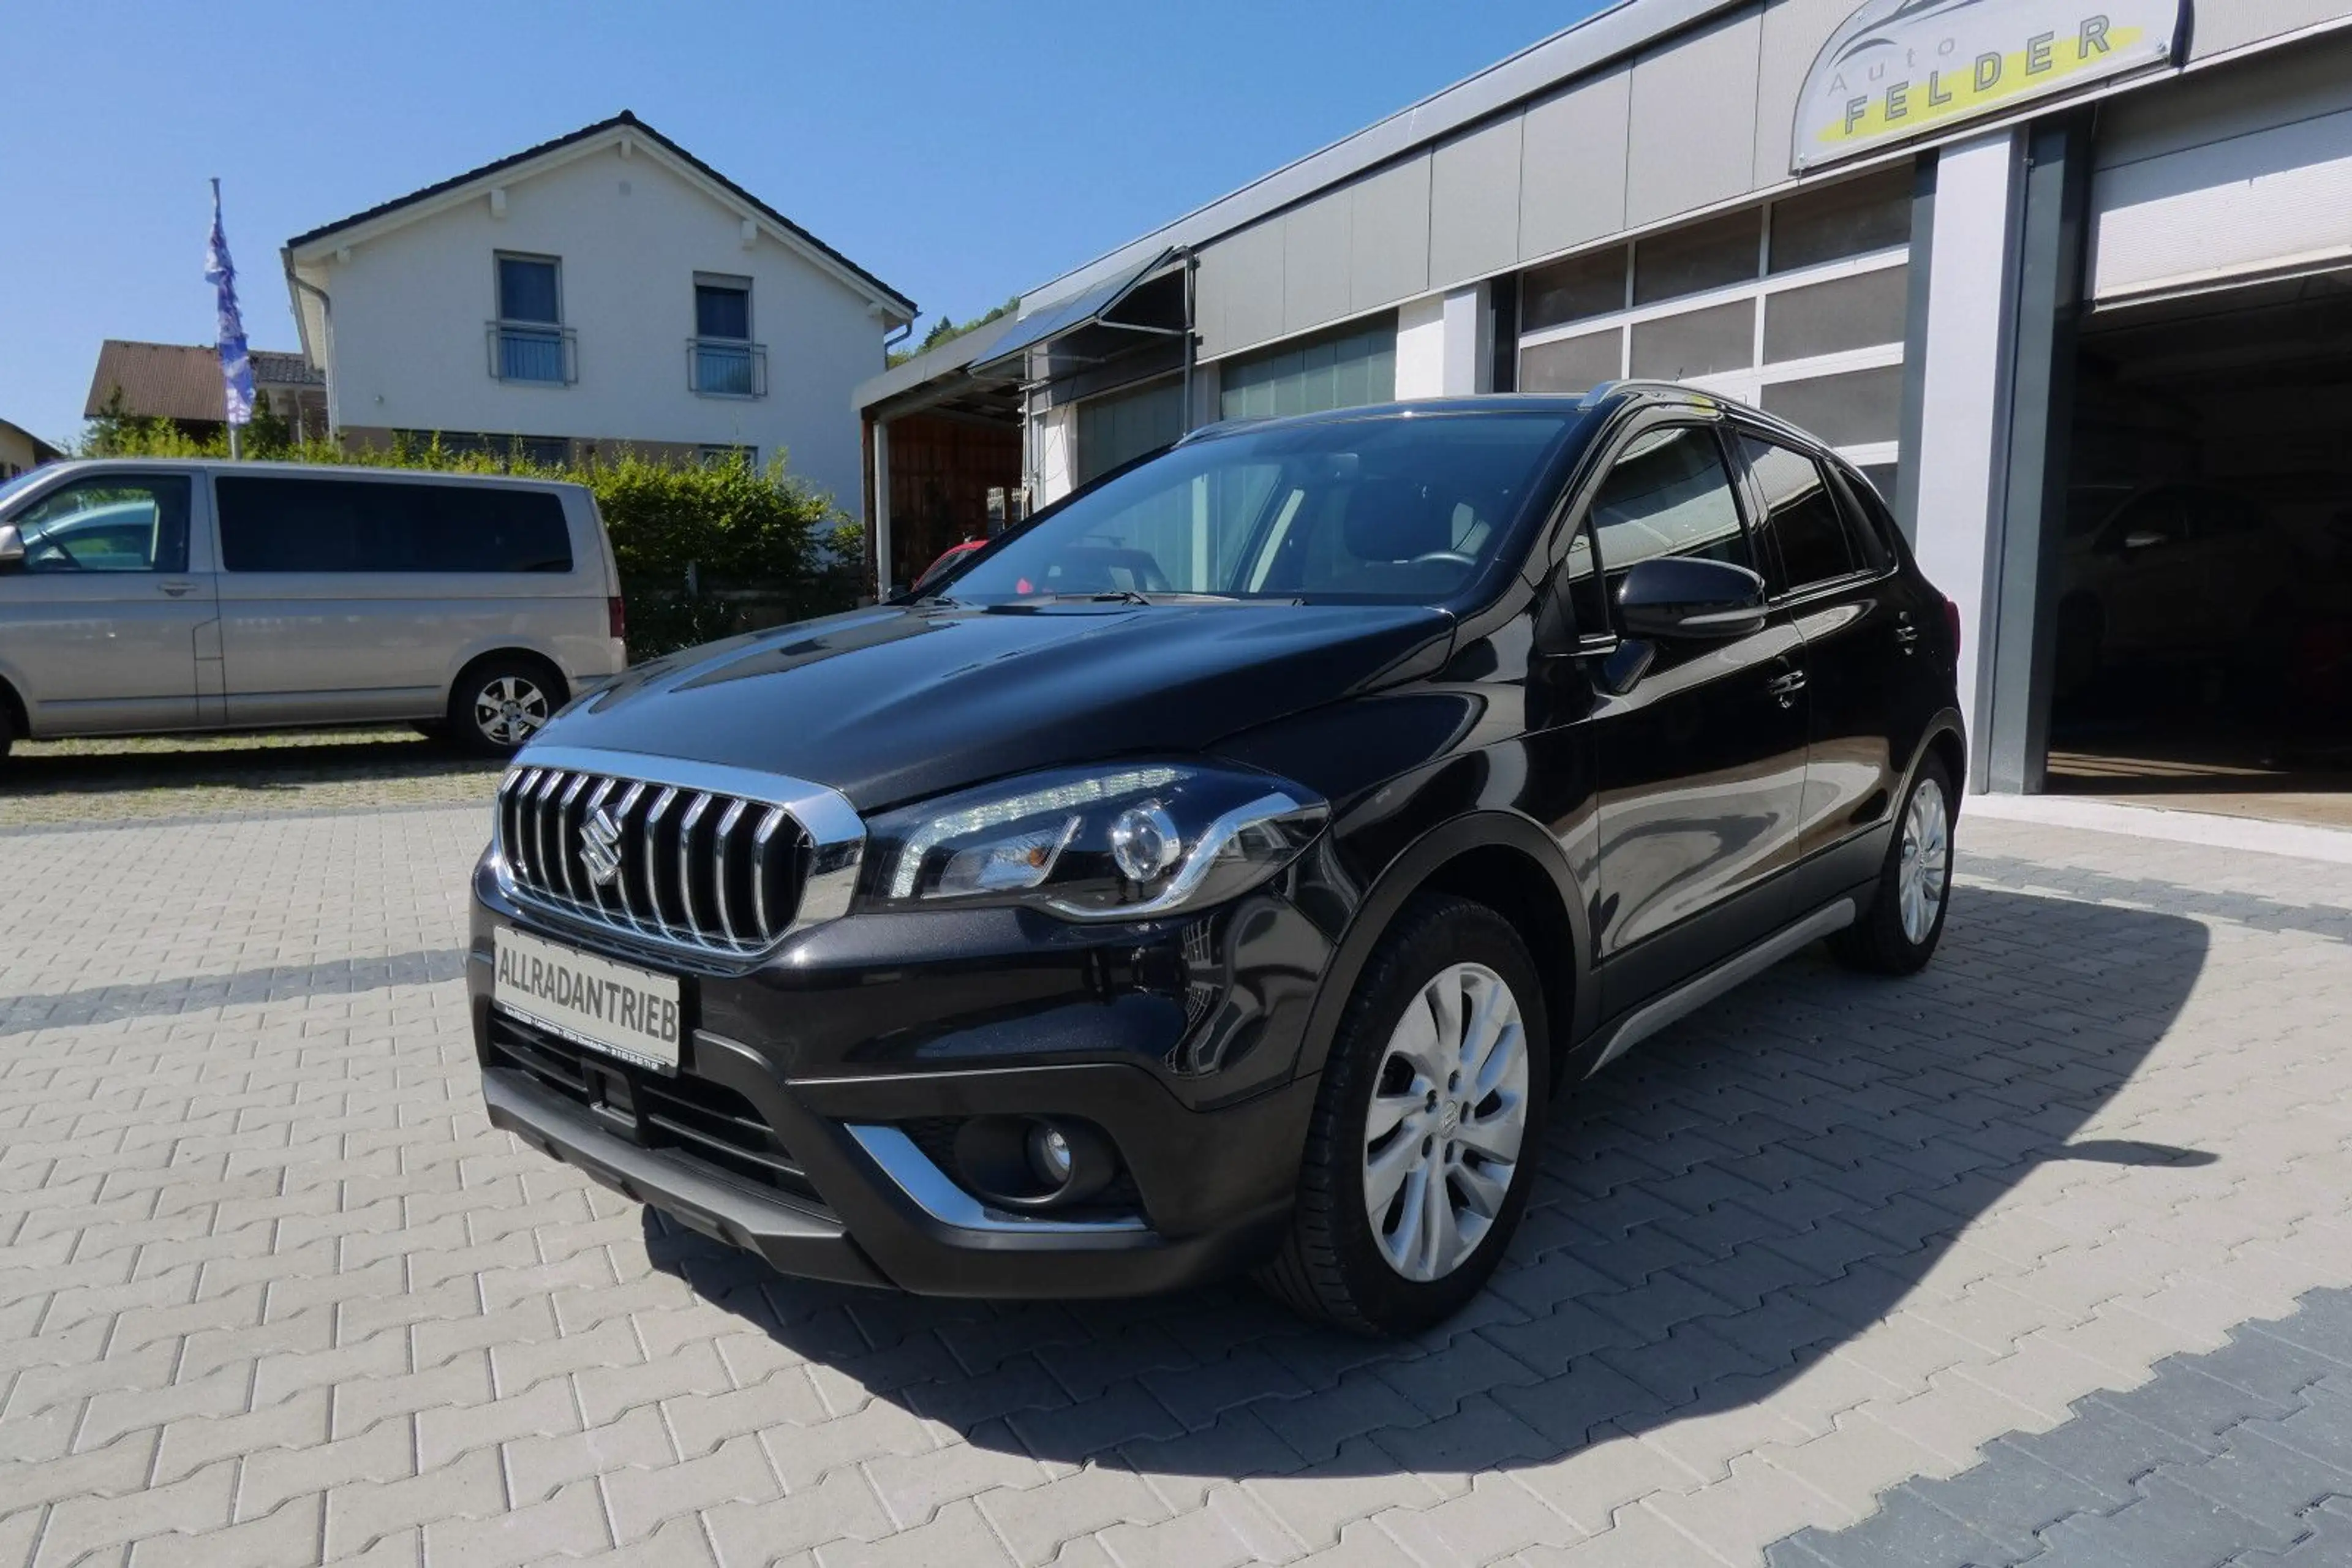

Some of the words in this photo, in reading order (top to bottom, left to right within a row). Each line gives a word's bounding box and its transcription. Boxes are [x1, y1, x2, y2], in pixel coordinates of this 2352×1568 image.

[1829, 39, 1954, 96] Auto
[1845, 15, 2110, 134] FELDER
[498, 947, 677, 1042] ALLRADANTRIEB
